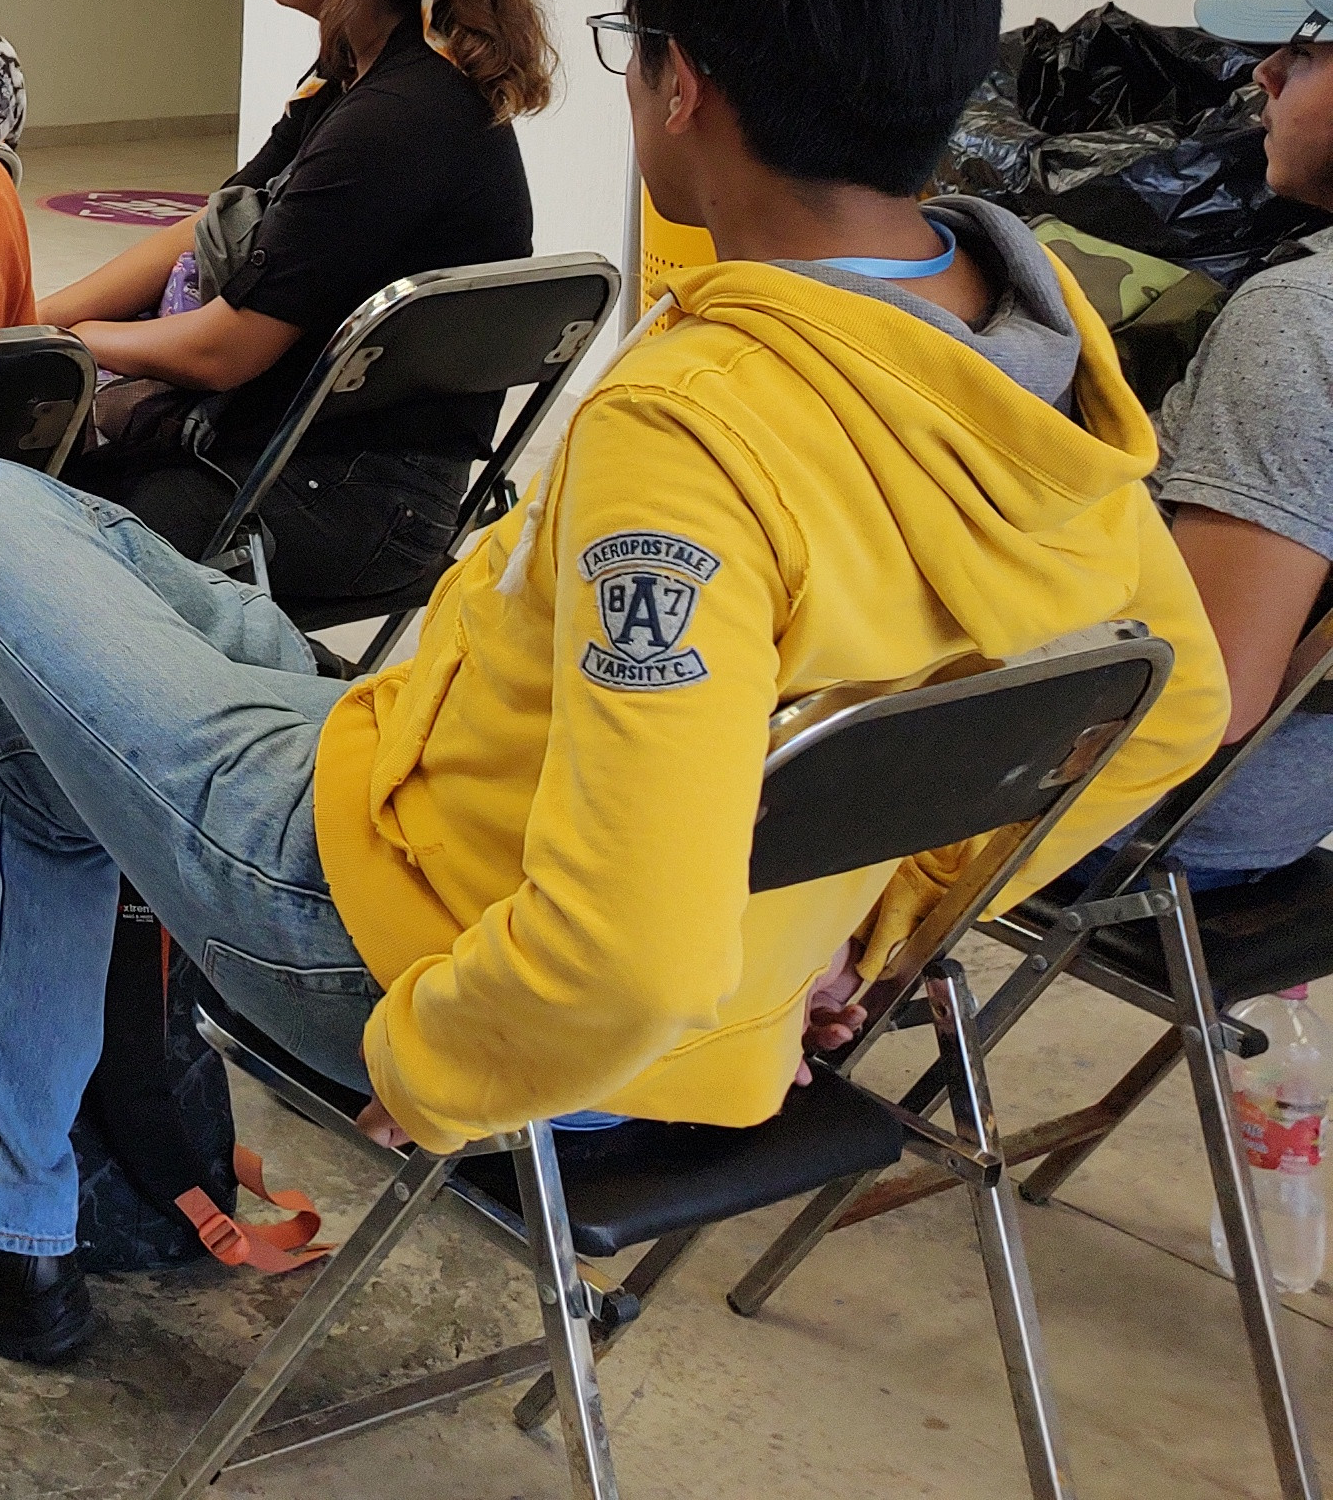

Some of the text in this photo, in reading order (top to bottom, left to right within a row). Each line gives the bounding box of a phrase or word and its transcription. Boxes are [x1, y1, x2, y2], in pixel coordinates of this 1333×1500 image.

[593, 539, 710, 572] AEROPOSTALE
[609, 576, 684, 647] 8 A 7
[596, 654, 668, 681] VARSITY
